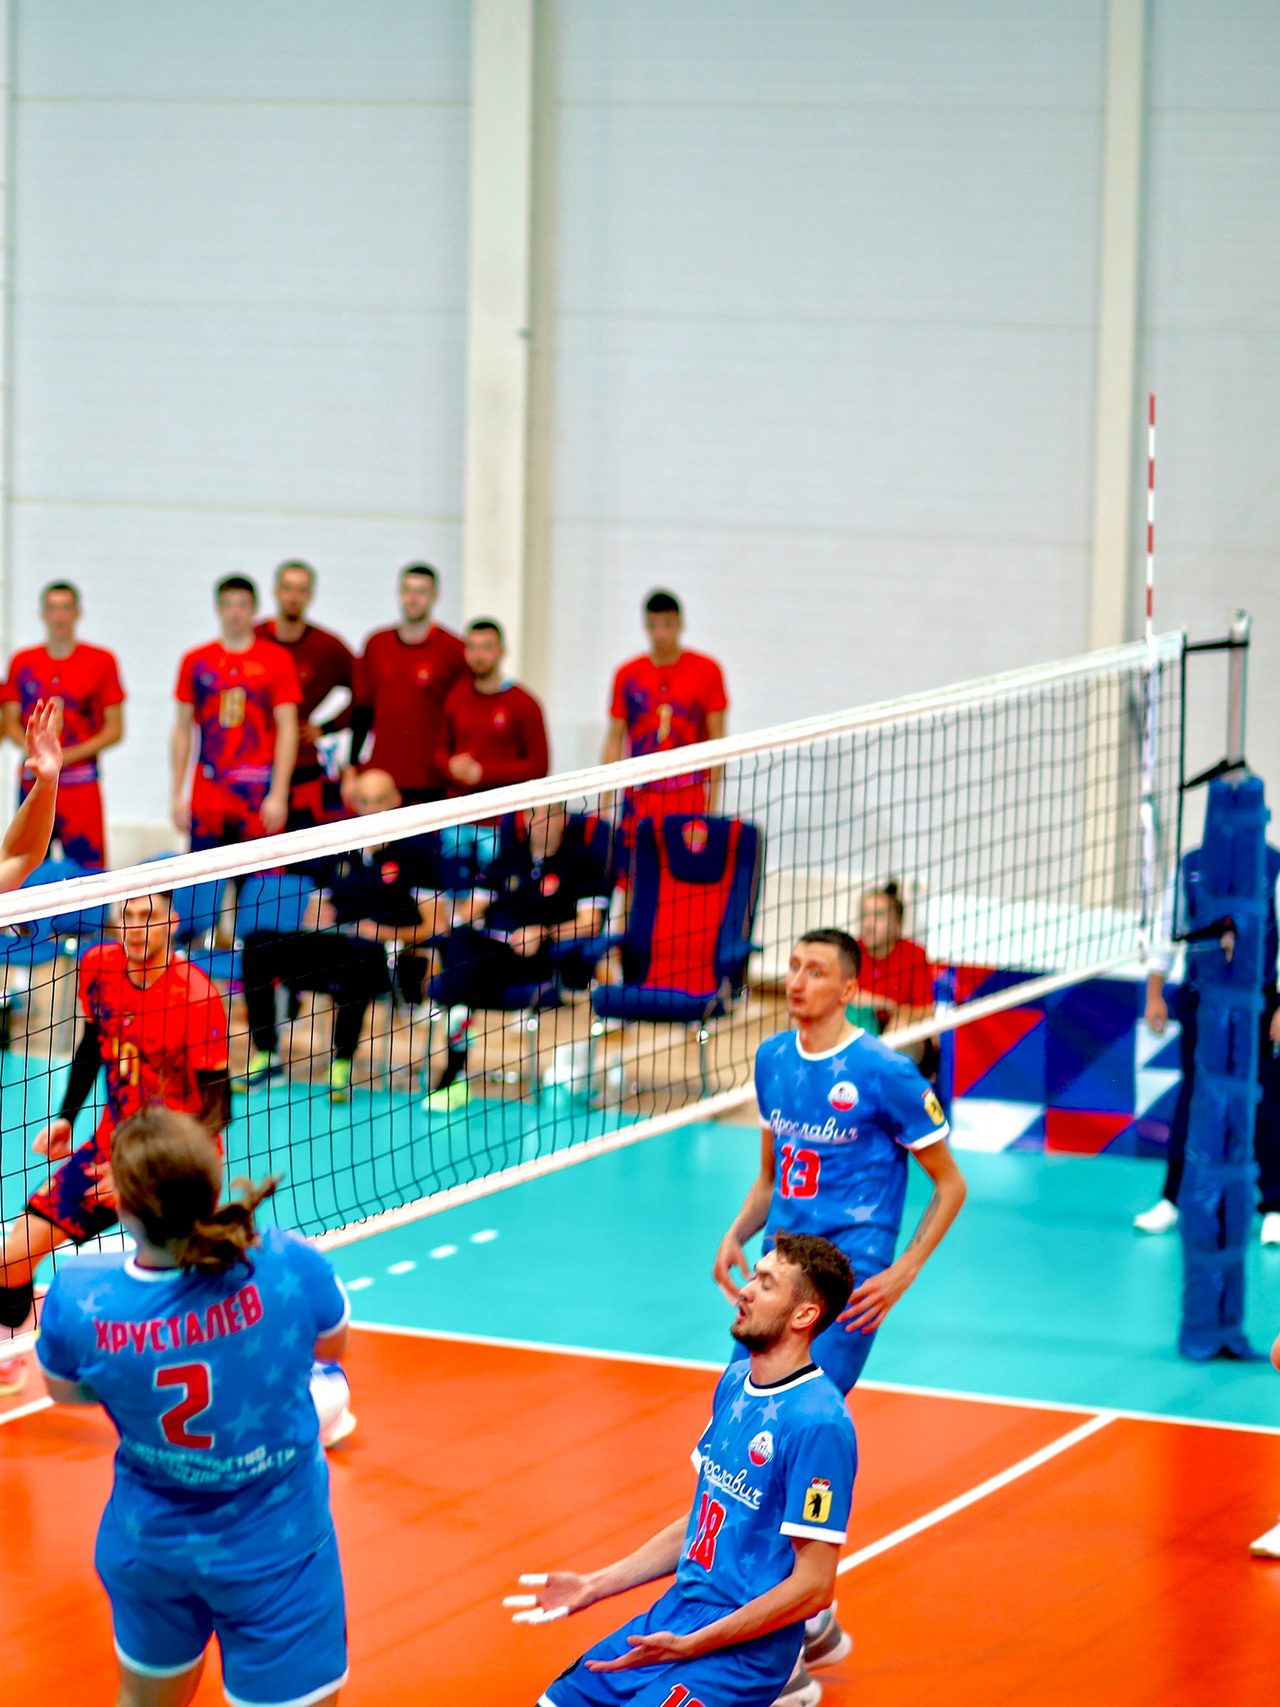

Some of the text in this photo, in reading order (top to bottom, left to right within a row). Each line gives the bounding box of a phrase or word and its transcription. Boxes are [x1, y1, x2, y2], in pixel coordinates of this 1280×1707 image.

[780, 1144, 821, 1199] 13
[94, 1283, 264, 1354] ХРУСТАЛЕВ
[153, 1360, 215, 1450] 2
[688, 1490, 727, 1572] 18
